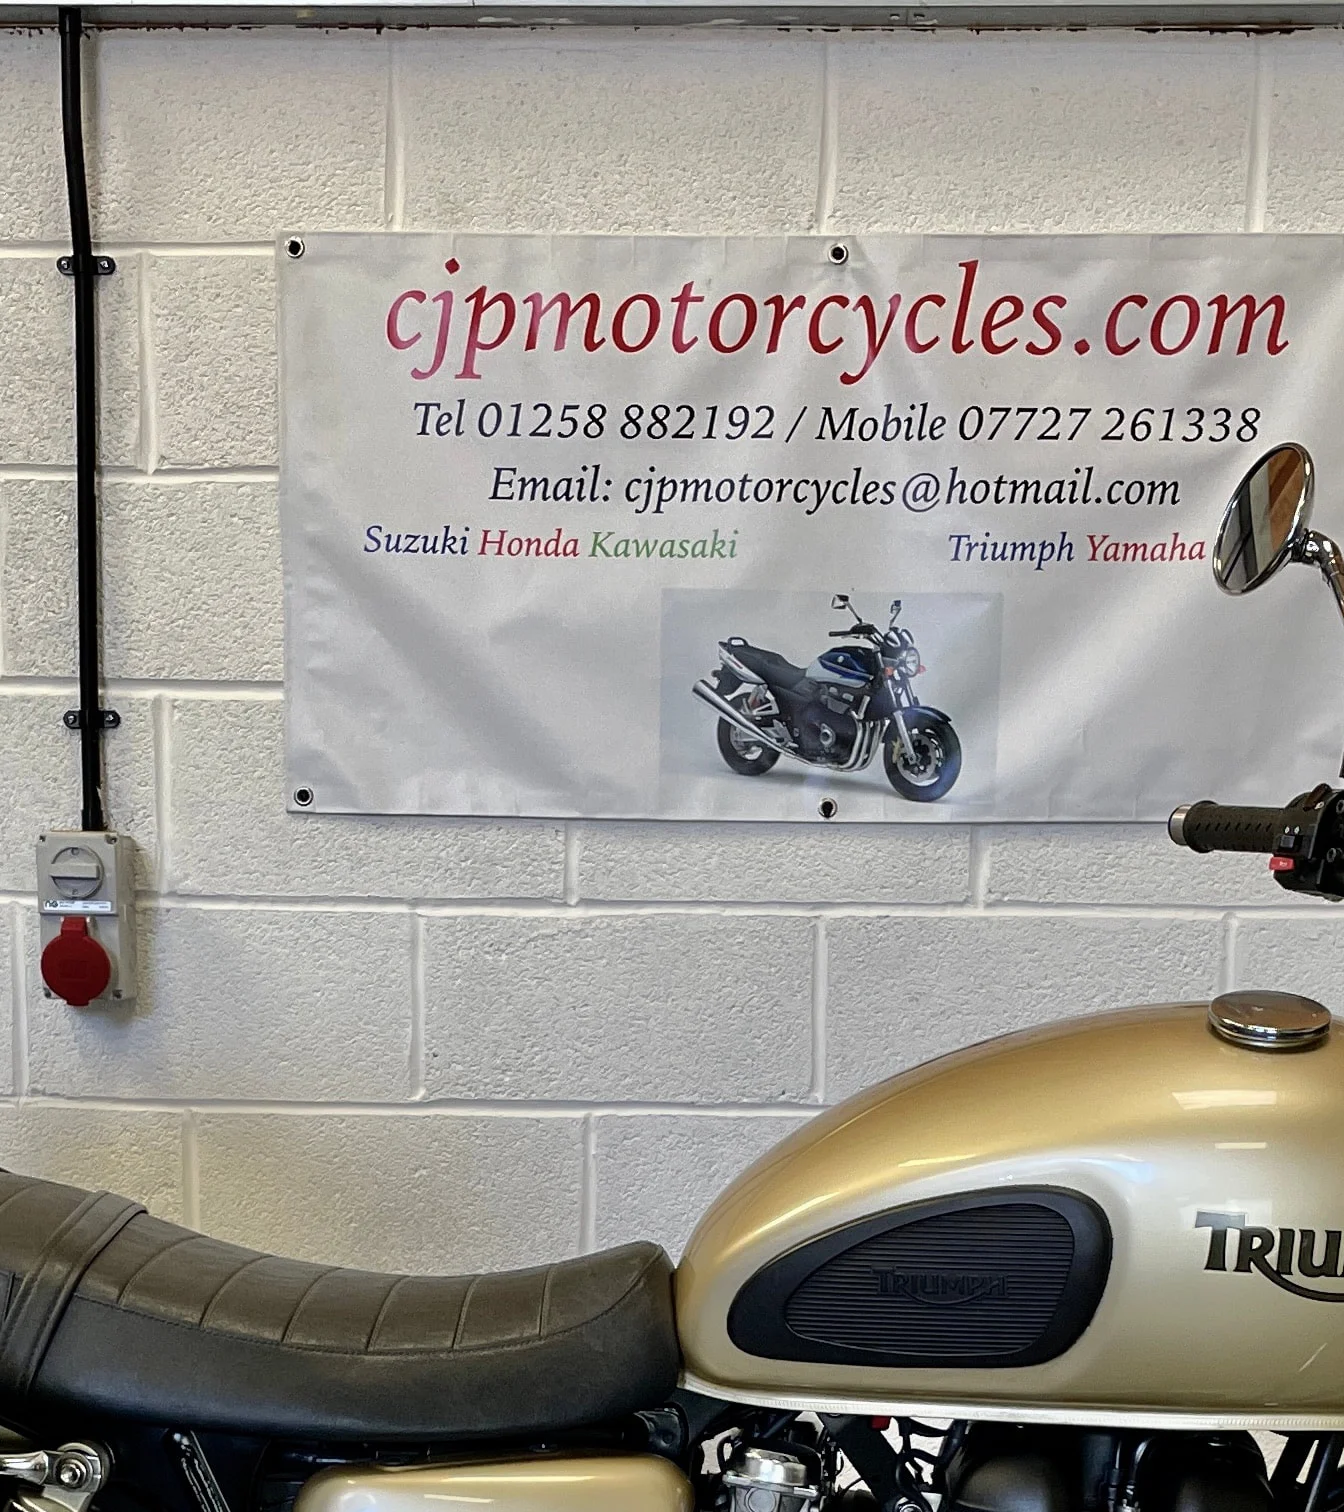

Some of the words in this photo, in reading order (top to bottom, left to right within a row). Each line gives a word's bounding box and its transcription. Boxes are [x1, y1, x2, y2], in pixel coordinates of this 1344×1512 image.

[385, 257, 1291, 386] cjpmotorcycles.com
[413, 398, 466, 437] Tel
[477, 401, 607, 438] 01258
[619, 403, 775, 440] 882192
[784, 404, 808, 444] /
[814, 402, 947, 442] Mobile
[958, 405, 1092, 442] 07727
[1100, 406, 1262, 443] 261338
[488, 465, 613, 503] Email:
[624, 466, 1182, 515] cjpmotorcycles@hotmail.com
[363, 524, 471, 557] Suzuki
[477, 528, 580, 559] Honda
[588, 529, 740, 560] Kawasaki
[948, 531, 1075, 571] Triumph
[1086, 533, 1206, 563] Yamaha
[870, 1264, 1007, 1305] TRIUMPH
